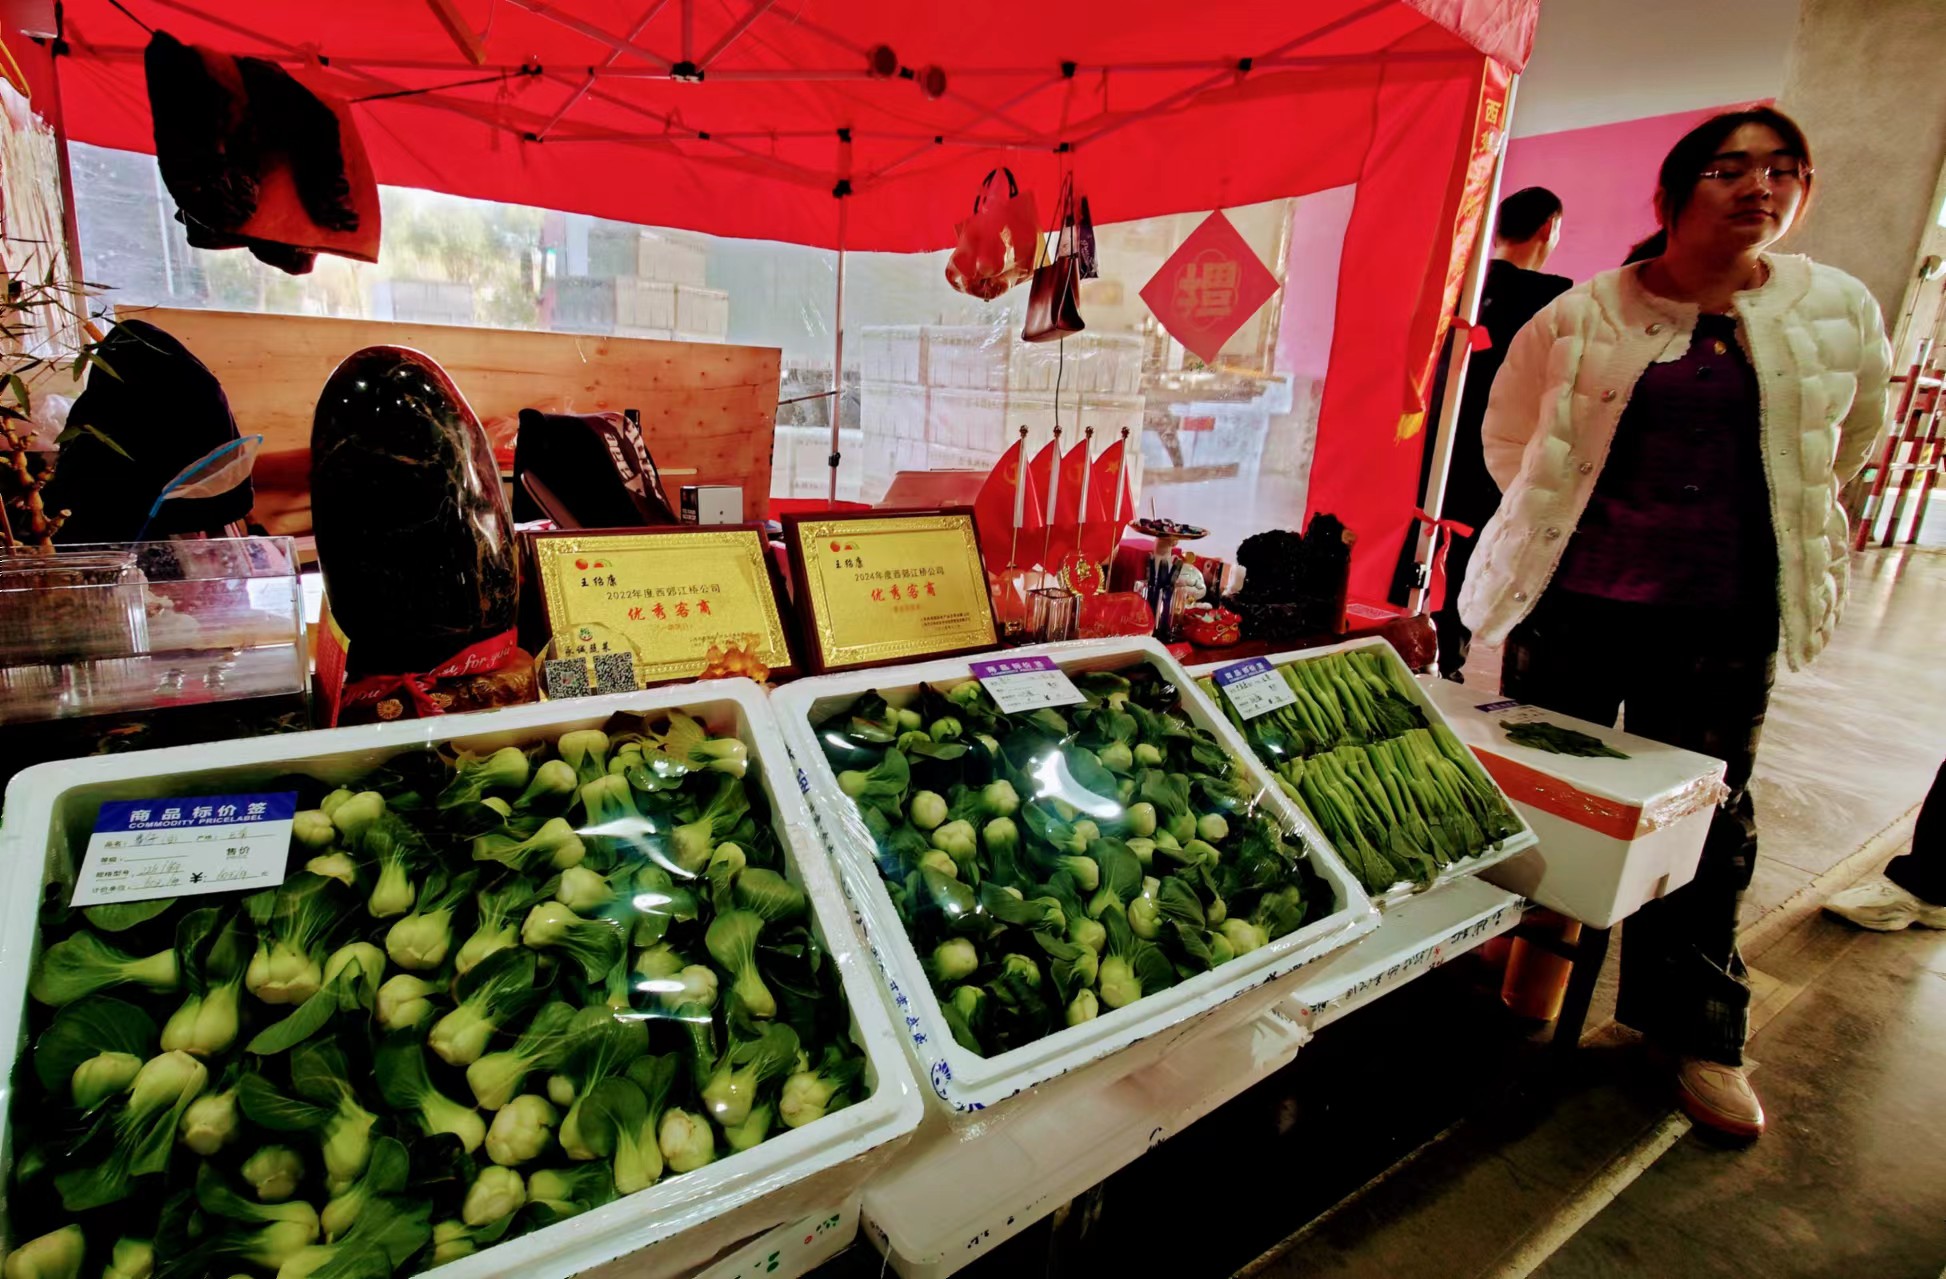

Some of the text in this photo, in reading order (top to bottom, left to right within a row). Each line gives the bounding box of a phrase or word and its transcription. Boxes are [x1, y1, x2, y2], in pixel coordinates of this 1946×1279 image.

[871, 581, 937, 603] 优秀客商
[628, 599, 713, 621] 优秀客商
[461, 653, 488, 675] for
[128, 813, 264, 830] COMMODITY PRICELABEL
[129, 801, 268, 823] 商品标价签
